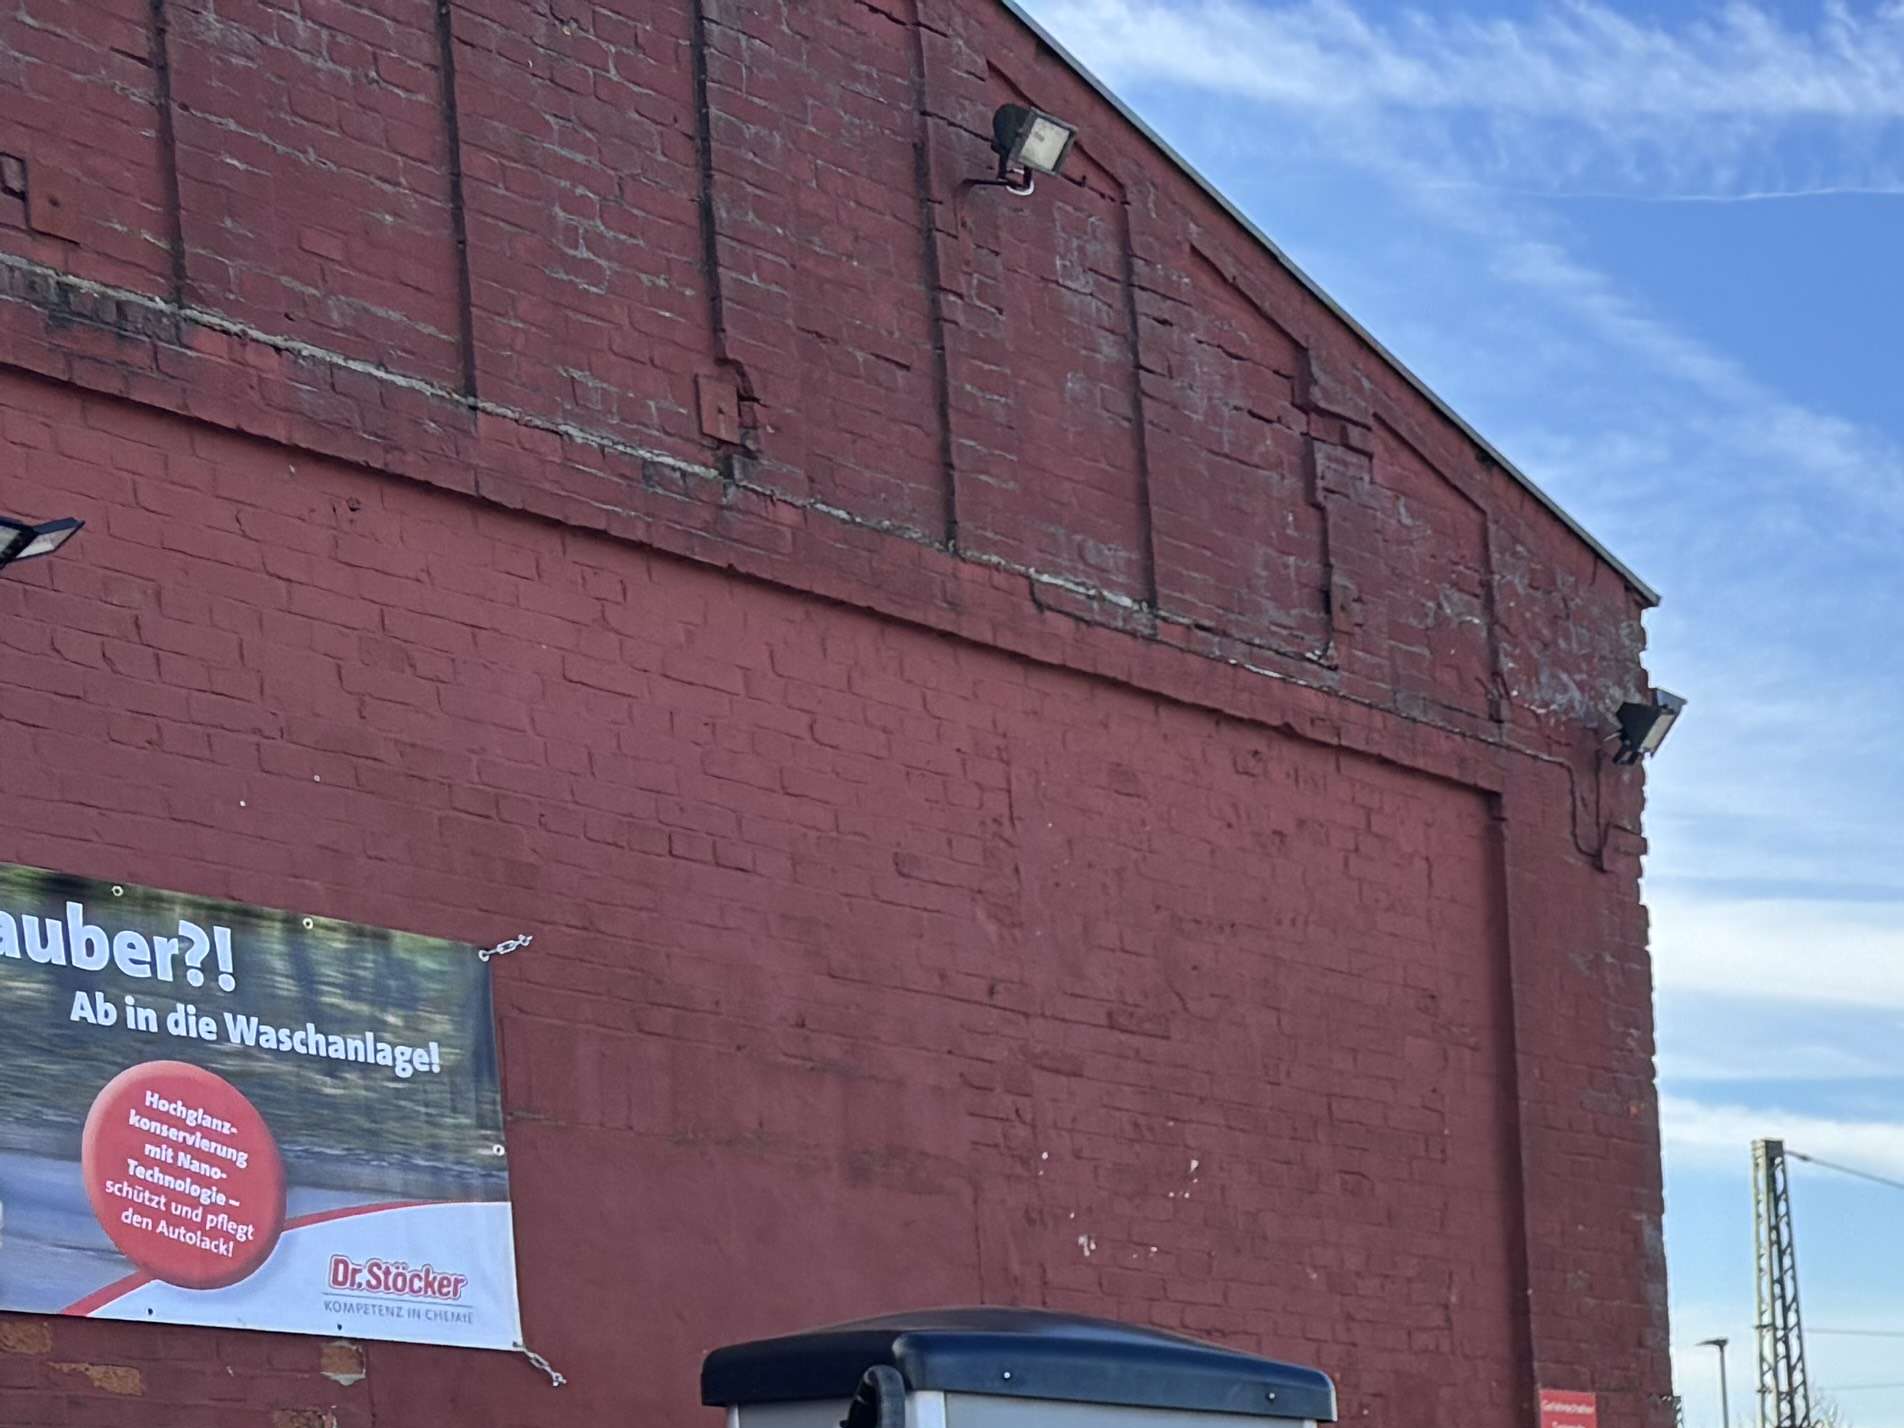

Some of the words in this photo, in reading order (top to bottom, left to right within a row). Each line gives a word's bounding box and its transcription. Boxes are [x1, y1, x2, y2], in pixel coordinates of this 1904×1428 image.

[70, 991, 117, 1027] Ab
[124, 995, 158, 1033] in
[167, 1002, 217, 1041] die
[223, 1012, 441, 1079] Waschanlage!
[145, 1090, 238, 1135] Hochglanz-
[129, 1109, 249, 1169] konservierung
[144, 1143, 174, 1163] mit
[177, 1151, 227, 1180] Nano-
[127, 1159, 226, 1206] Technologie
[105, 1180, 167, 1211] schützt
[171, 1201, 203, 1223] und
[205, 1213, 255, 1242] pflegt
[121, 1208, 152, 1231] den
[156, 1219, 234, 1257] Autolack!
[324, 1301, 405, 1319] KOMPETENZ
[408, 1307, 421, 1320] IN
